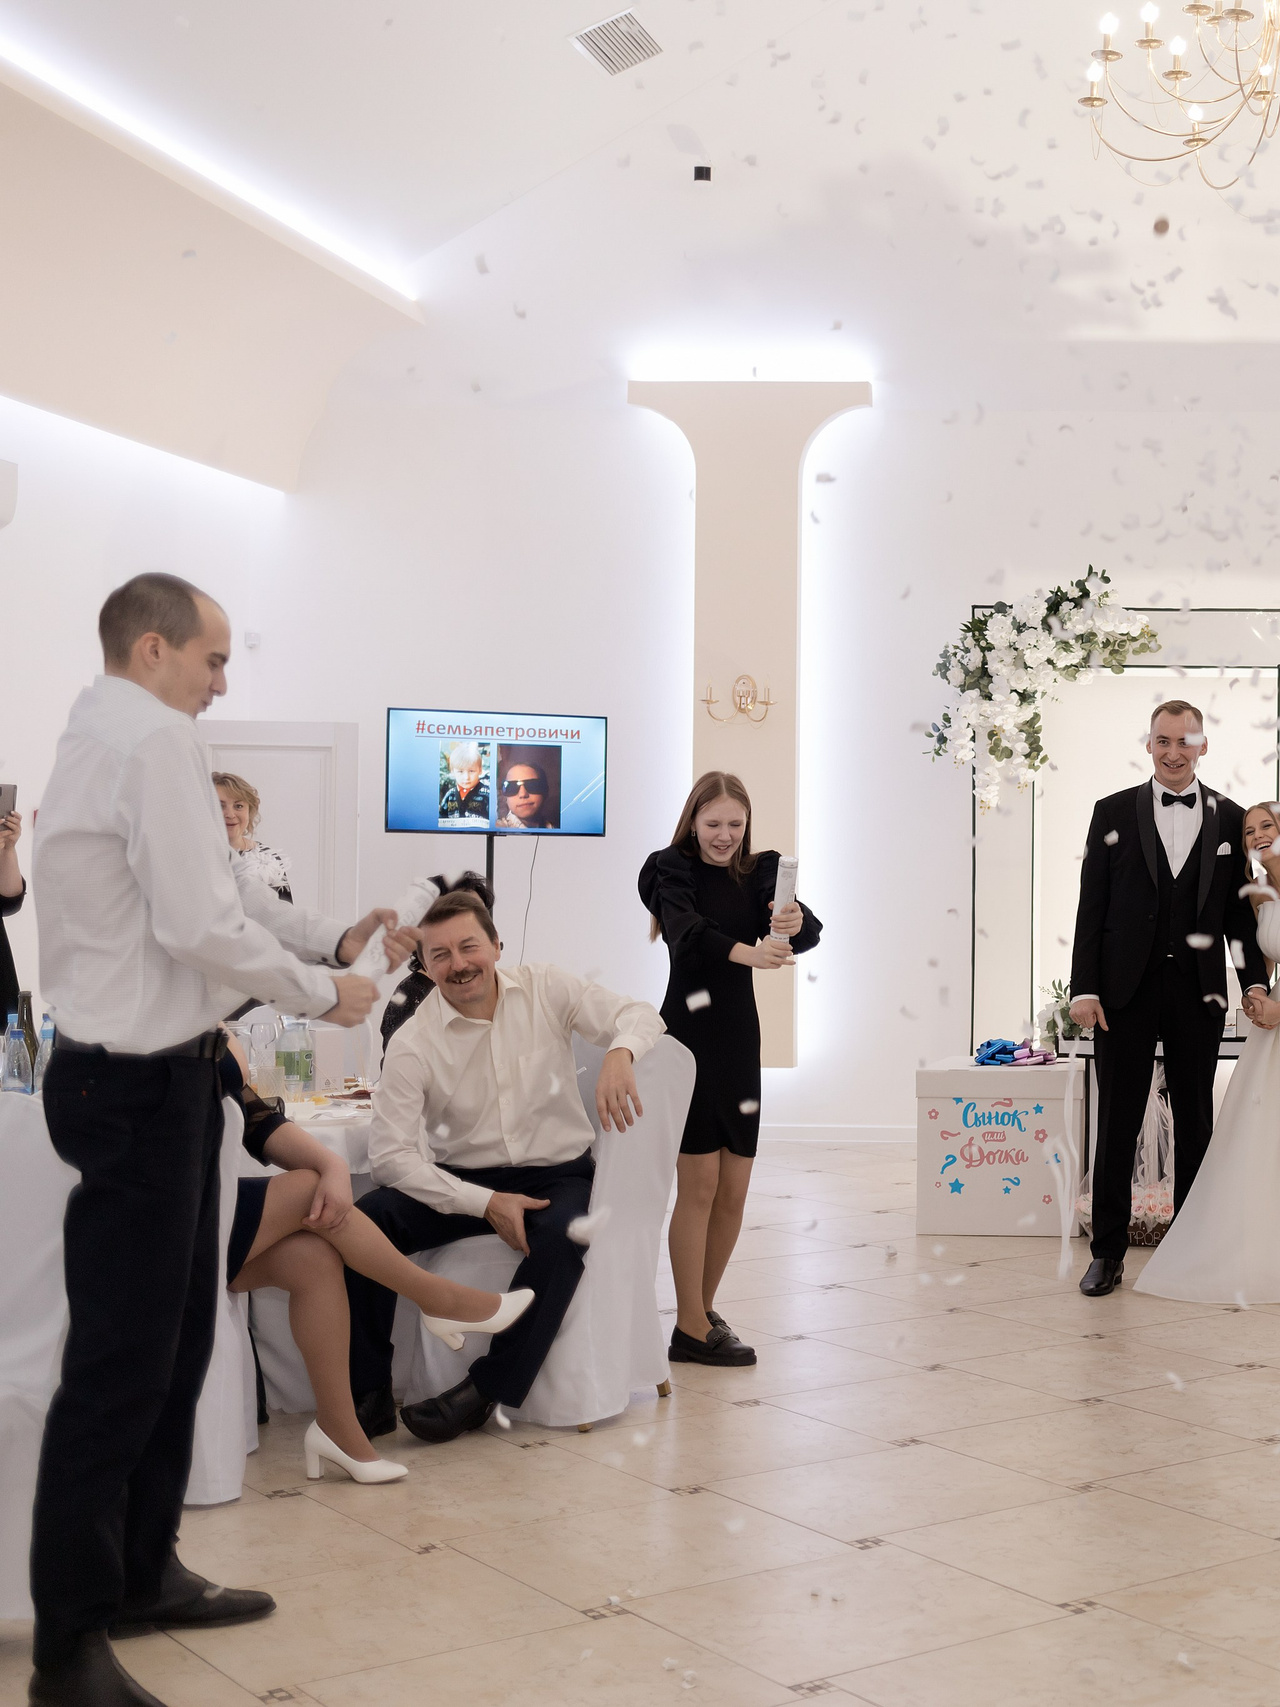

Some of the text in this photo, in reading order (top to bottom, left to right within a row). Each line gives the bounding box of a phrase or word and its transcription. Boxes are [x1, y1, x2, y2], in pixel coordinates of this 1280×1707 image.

[415, 720, 581, 740] #семьяпетровичи
[962, 1102, 1029, 1132] Сынок
[984, 1132, 1004, 1141] или
[960, 1136, 1029, 1169] Дочка
